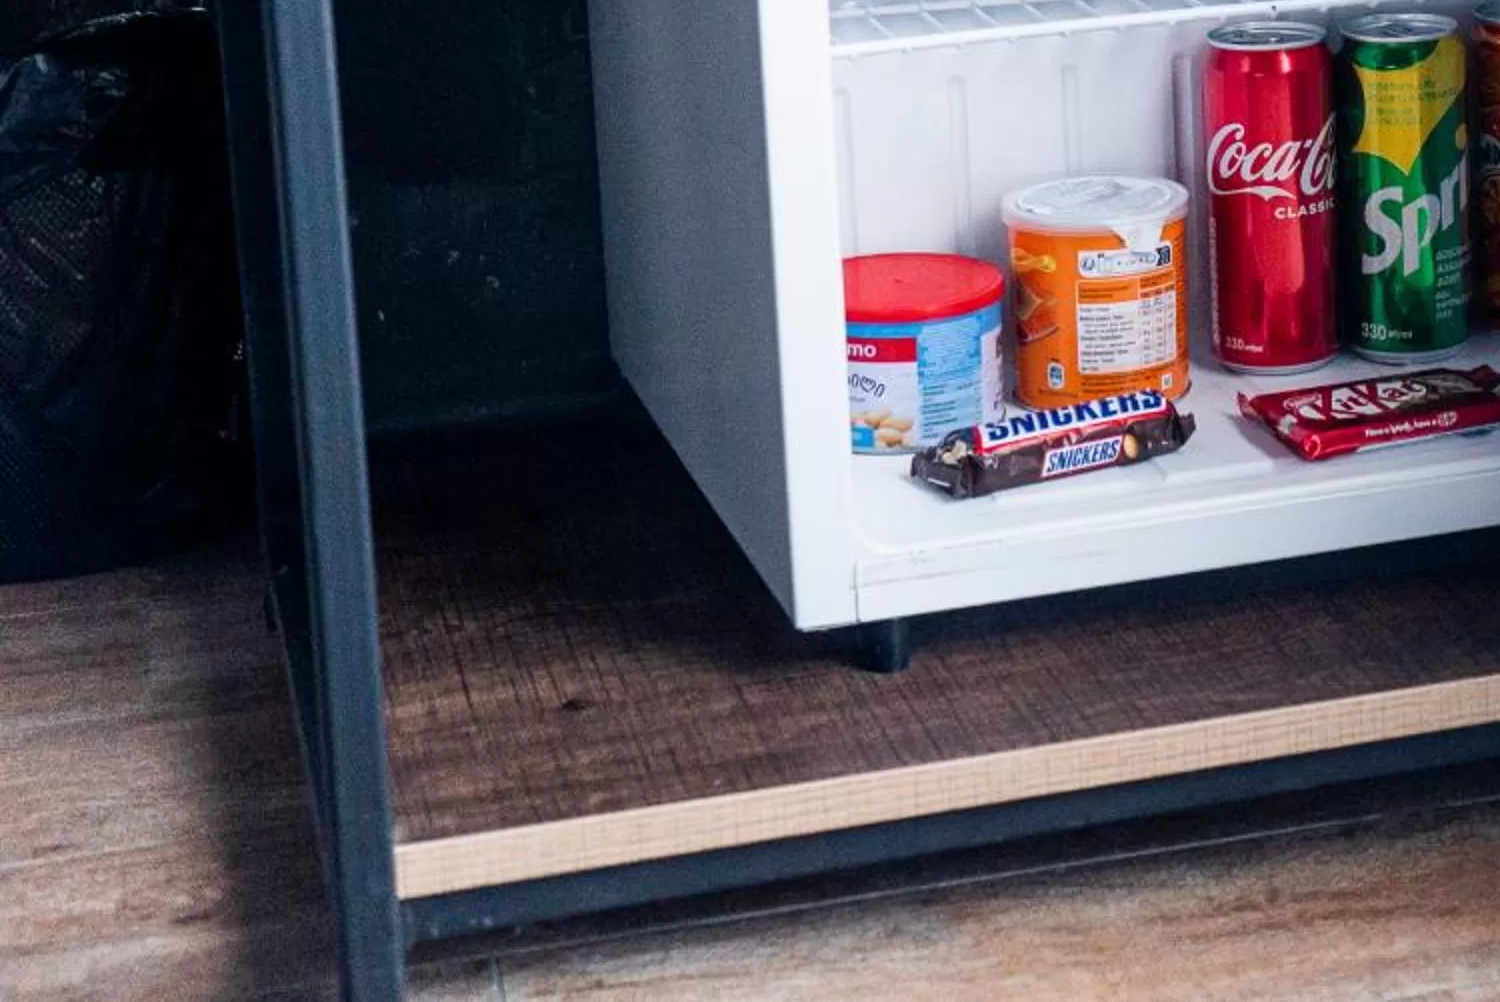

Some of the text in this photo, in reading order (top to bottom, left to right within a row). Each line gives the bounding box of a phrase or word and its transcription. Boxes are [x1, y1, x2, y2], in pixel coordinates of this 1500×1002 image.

[1361, 322, 1386, 341] 330
[988, 389, 1164, 442] SNICKERS
[1046, 441, 1120, 472] SNICKERS
